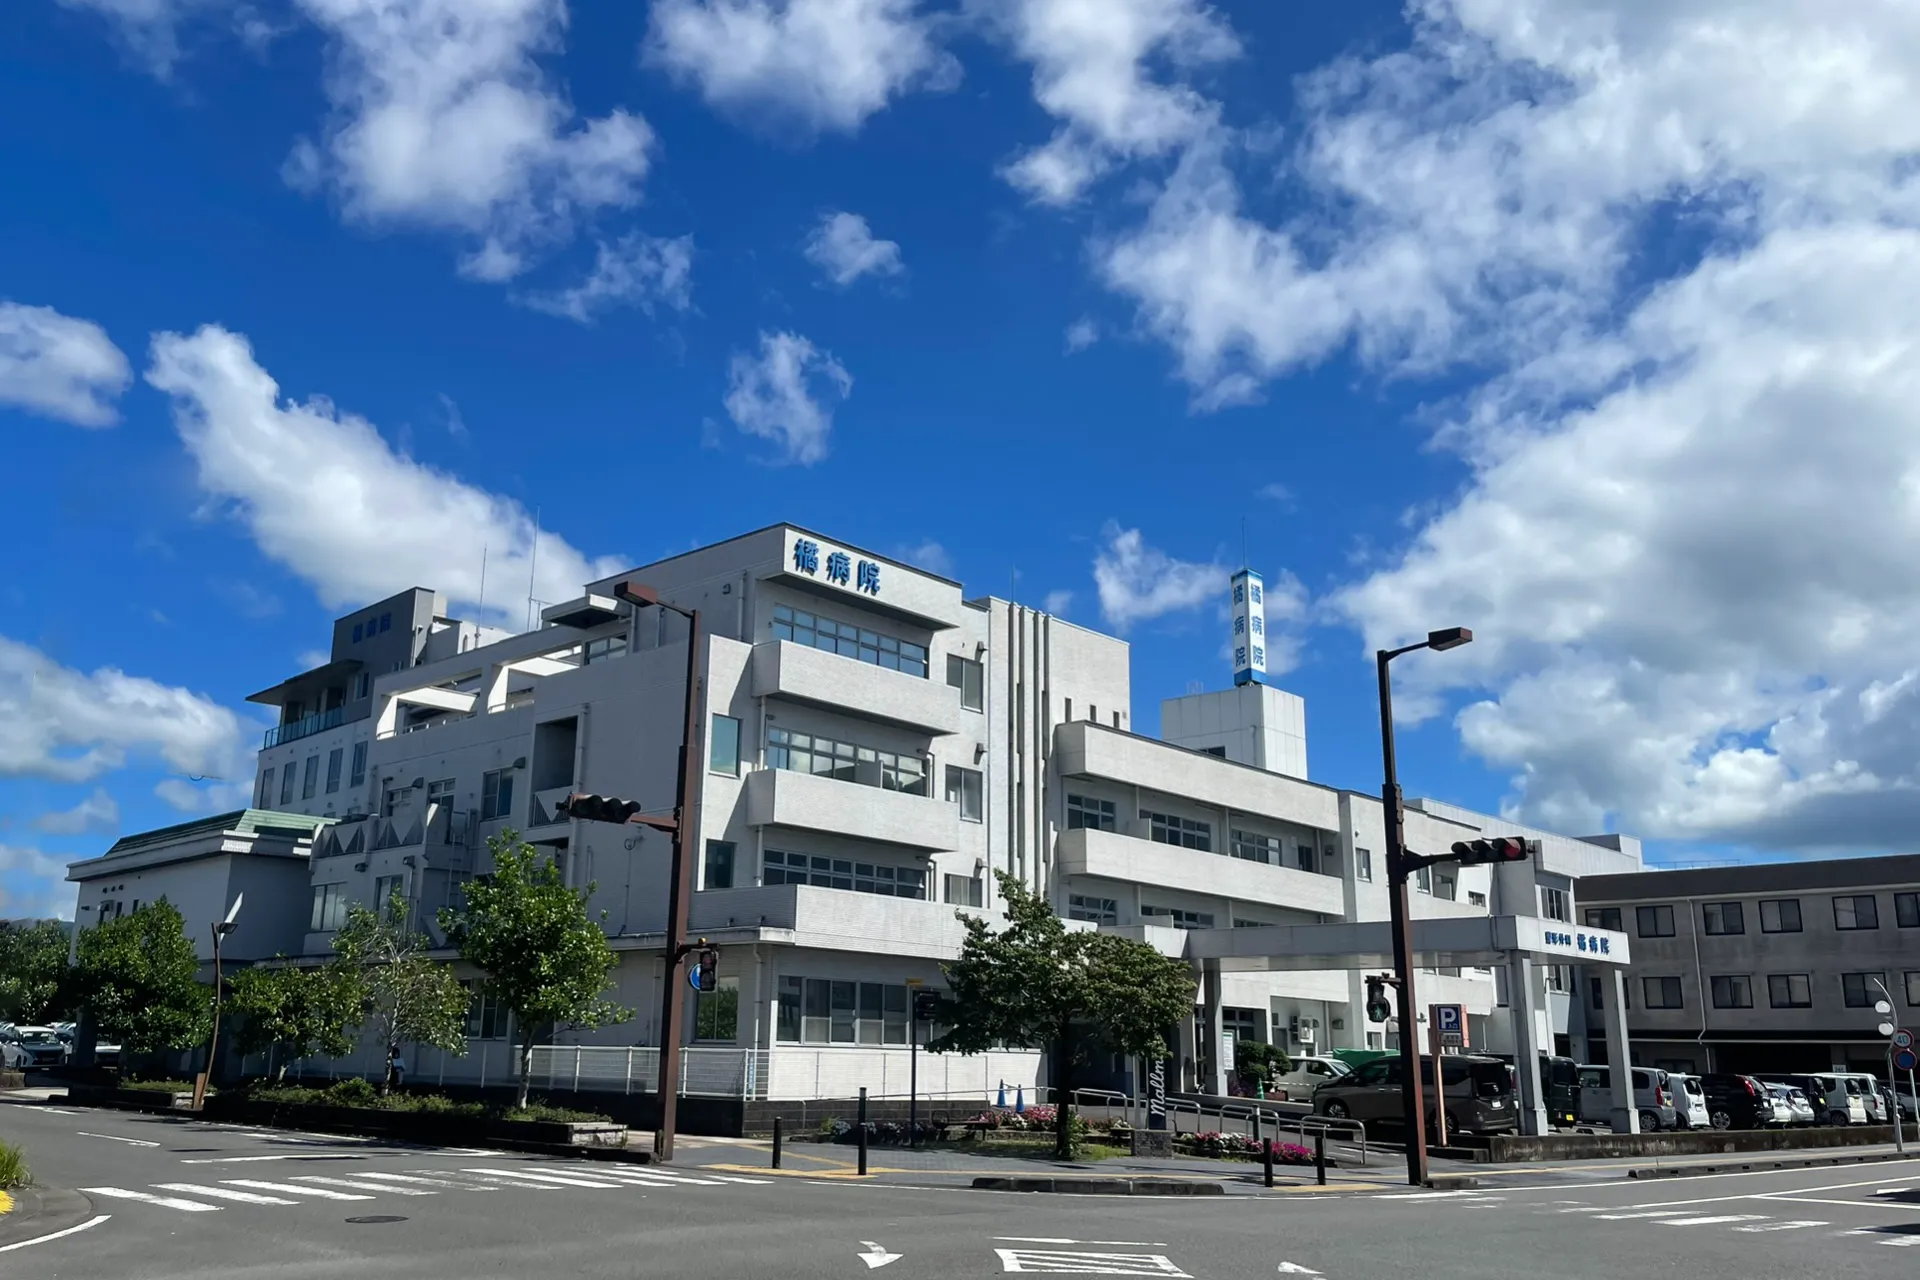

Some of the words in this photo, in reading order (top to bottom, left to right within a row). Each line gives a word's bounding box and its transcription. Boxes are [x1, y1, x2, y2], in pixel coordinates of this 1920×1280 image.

[793, 538, 881, 595] 橘病院
[1233, 584, 1246, 667] 橘病院
[1251, 583, 1264, 667] 橘病院
[1440, 1007, 1457, 1029] P
[1150, 1056, 1166, 1117] Mallm
